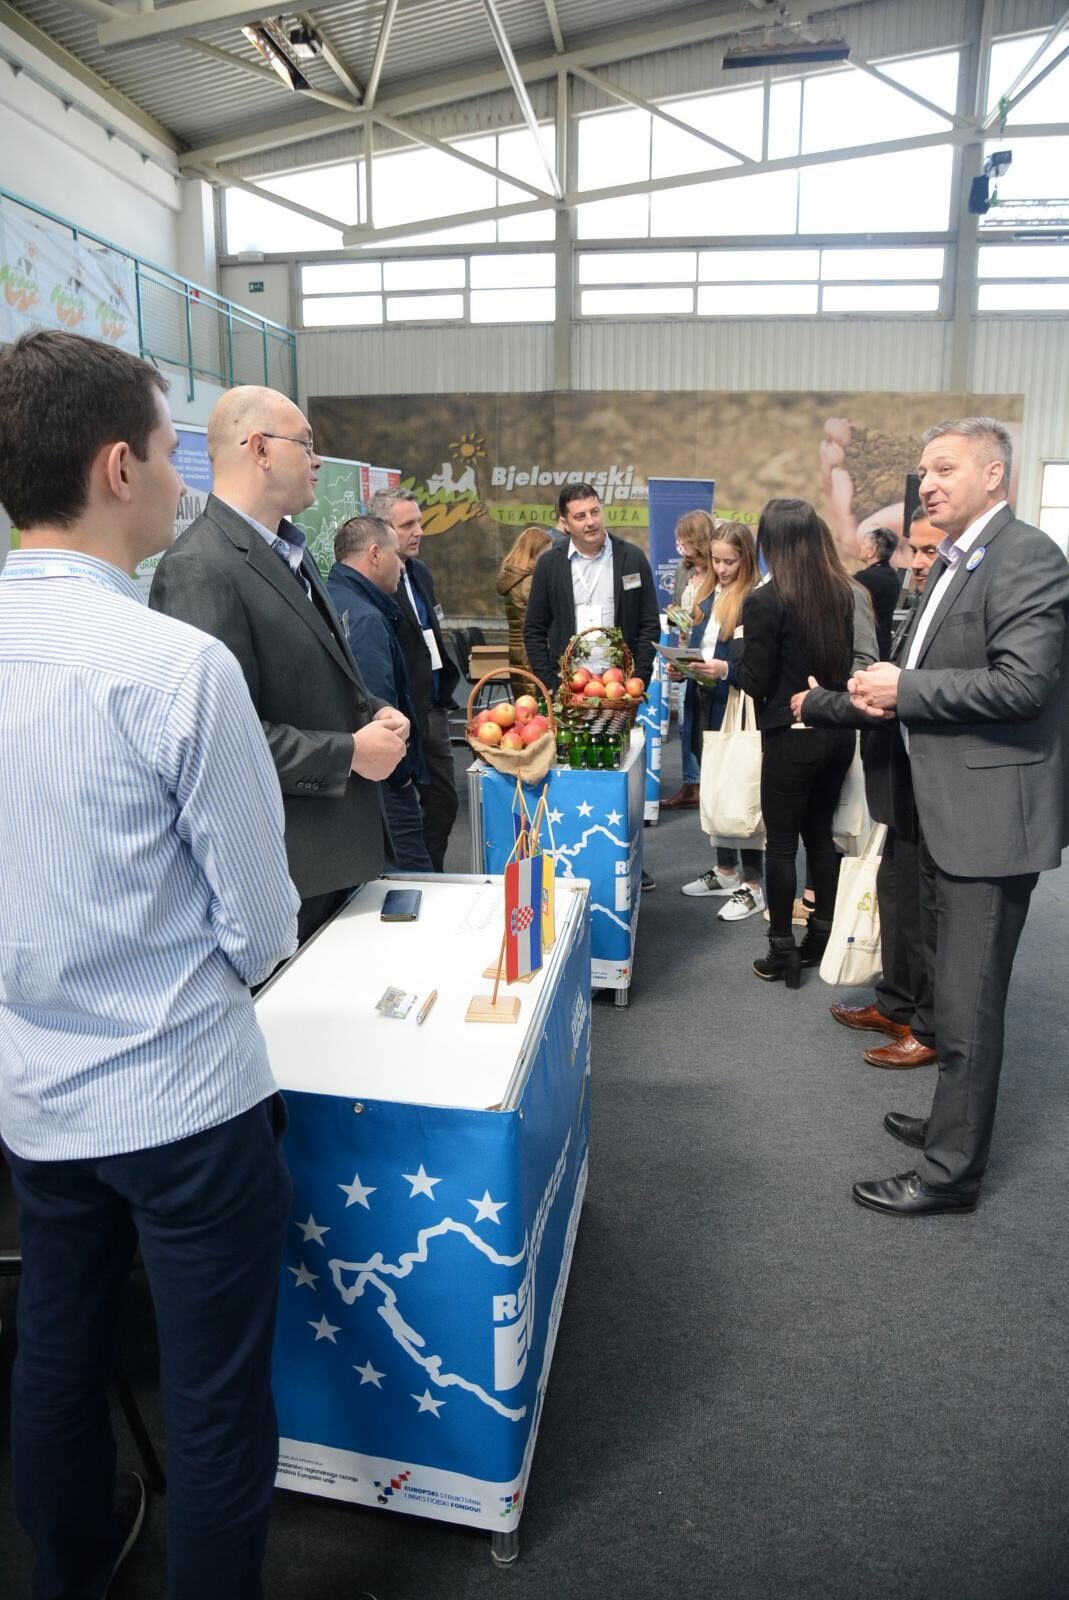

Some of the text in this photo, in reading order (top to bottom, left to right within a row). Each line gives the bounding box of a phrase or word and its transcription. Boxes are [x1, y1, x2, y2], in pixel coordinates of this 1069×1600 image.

[491, 464, 634, 491] Bjelovarski
[498, 509, 557, 521] TRADIC
[608, 505, 640, 521] UŽA
[404, 1485, 439, 1497] EUROPSKI
[450, 1502, 481, 1513] FONDOVI
